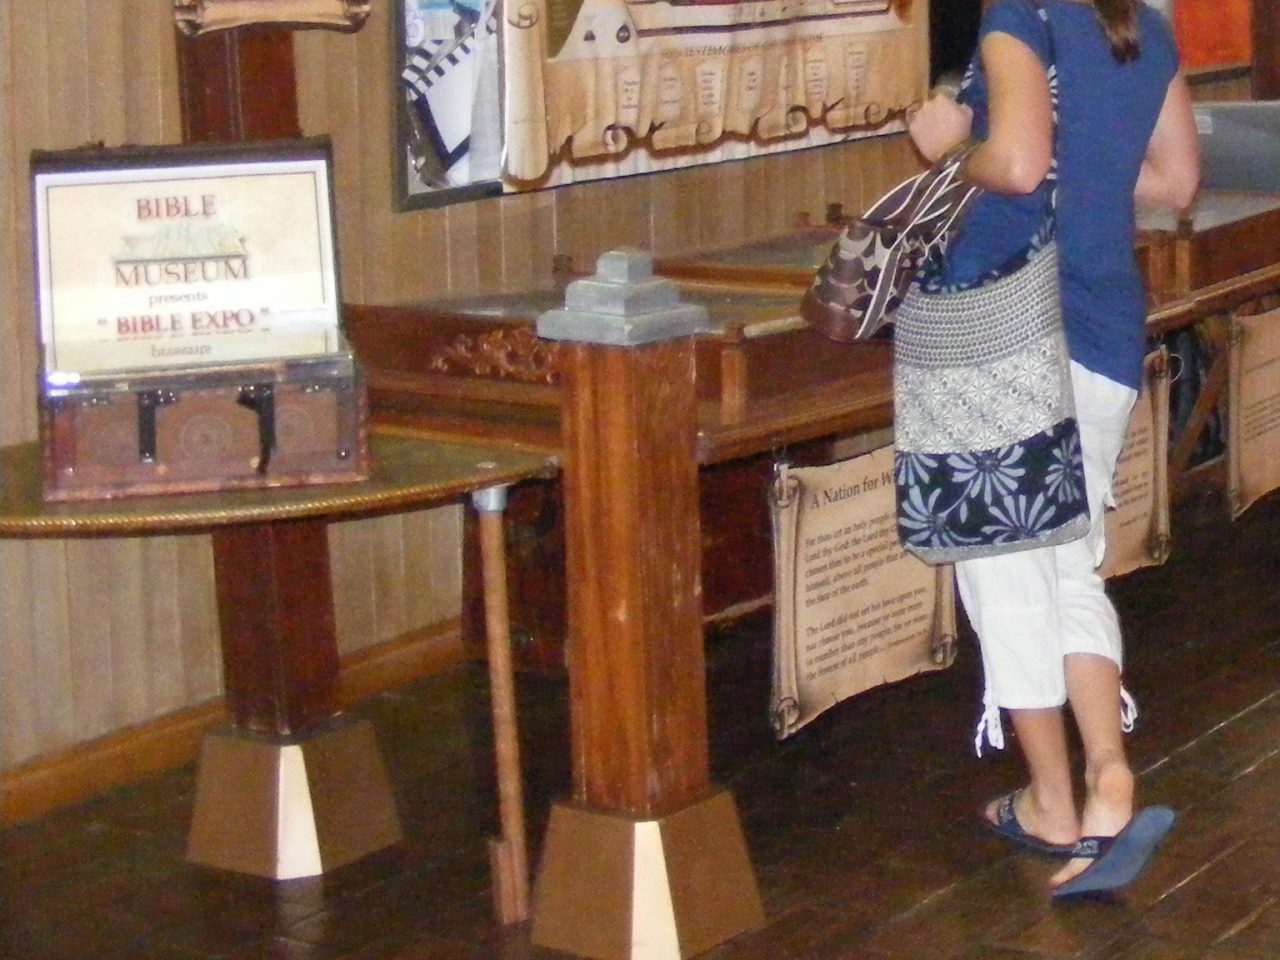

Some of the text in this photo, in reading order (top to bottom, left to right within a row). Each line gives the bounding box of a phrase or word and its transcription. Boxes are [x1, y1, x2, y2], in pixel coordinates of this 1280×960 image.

[136, 195, 217, 220] BIBLE
[115, 257, 250, 286] MUSEUM
[149, 291, 208, 307] presents
[823, 483, 860, 504] Nation
[863, 475, 878, 492] for
